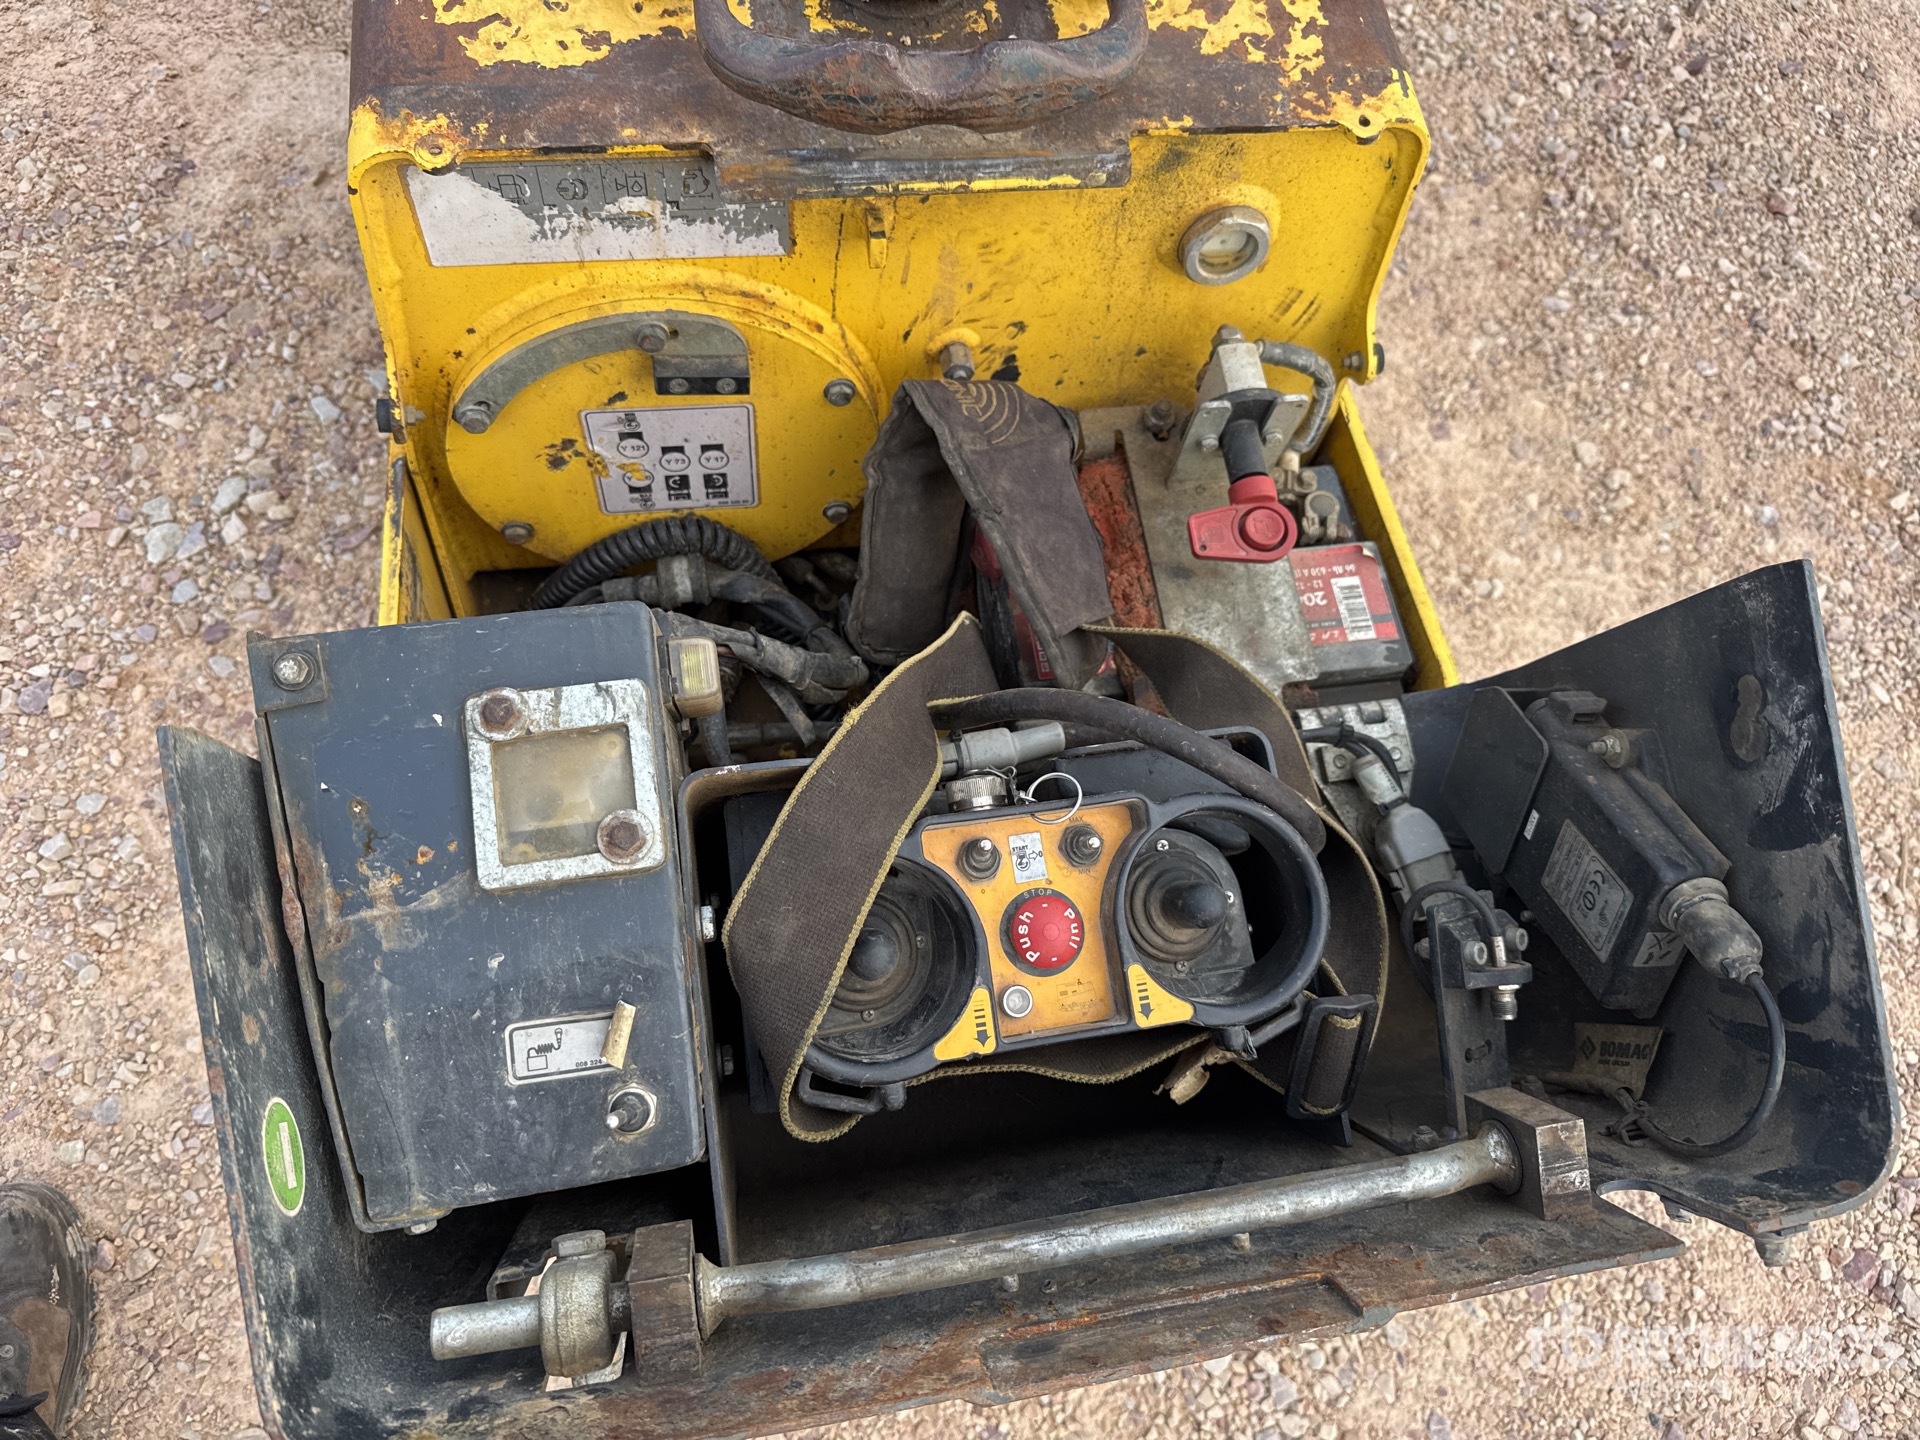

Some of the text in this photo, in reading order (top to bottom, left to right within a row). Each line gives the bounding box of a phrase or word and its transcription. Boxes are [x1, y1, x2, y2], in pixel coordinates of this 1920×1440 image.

[674, 457, 686, 465] 73
[1300, 591, 1328, 607] 20
[1012, 844, 1029, 853] START
[1023, 888, 1053, 899] STOP
[1063, 907, 1081, 949] Pull
[1017, 911, 1041, 963] Push
